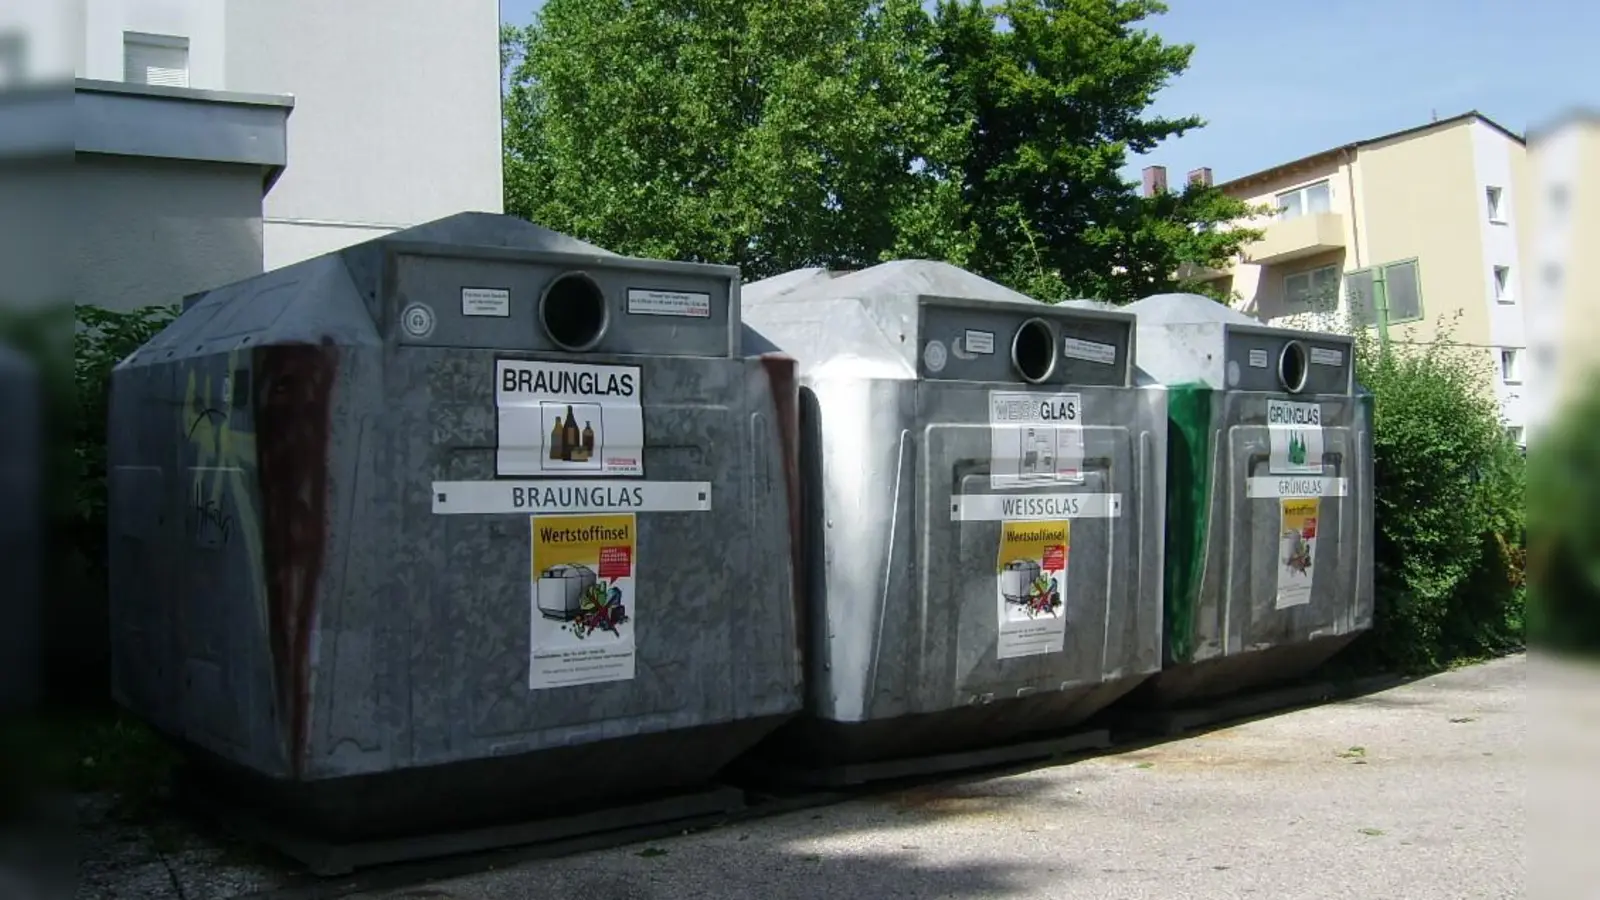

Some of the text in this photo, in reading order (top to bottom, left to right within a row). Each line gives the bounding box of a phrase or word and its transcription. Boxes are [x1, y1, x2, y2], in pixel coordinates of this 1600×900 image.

[503, 368, 634, 396] BRAUNGLAS
[1269, 403, 1319, 425] GRÜNGLAS
[1279, 478, 1322, 494] GRÜNGLAS
[513, 487, 643, 508] BRAUNGLAS
[1003, 498, 1079, 516] WEISSGLAS
[540, 525, 629, 543] Wertstoffinsel
